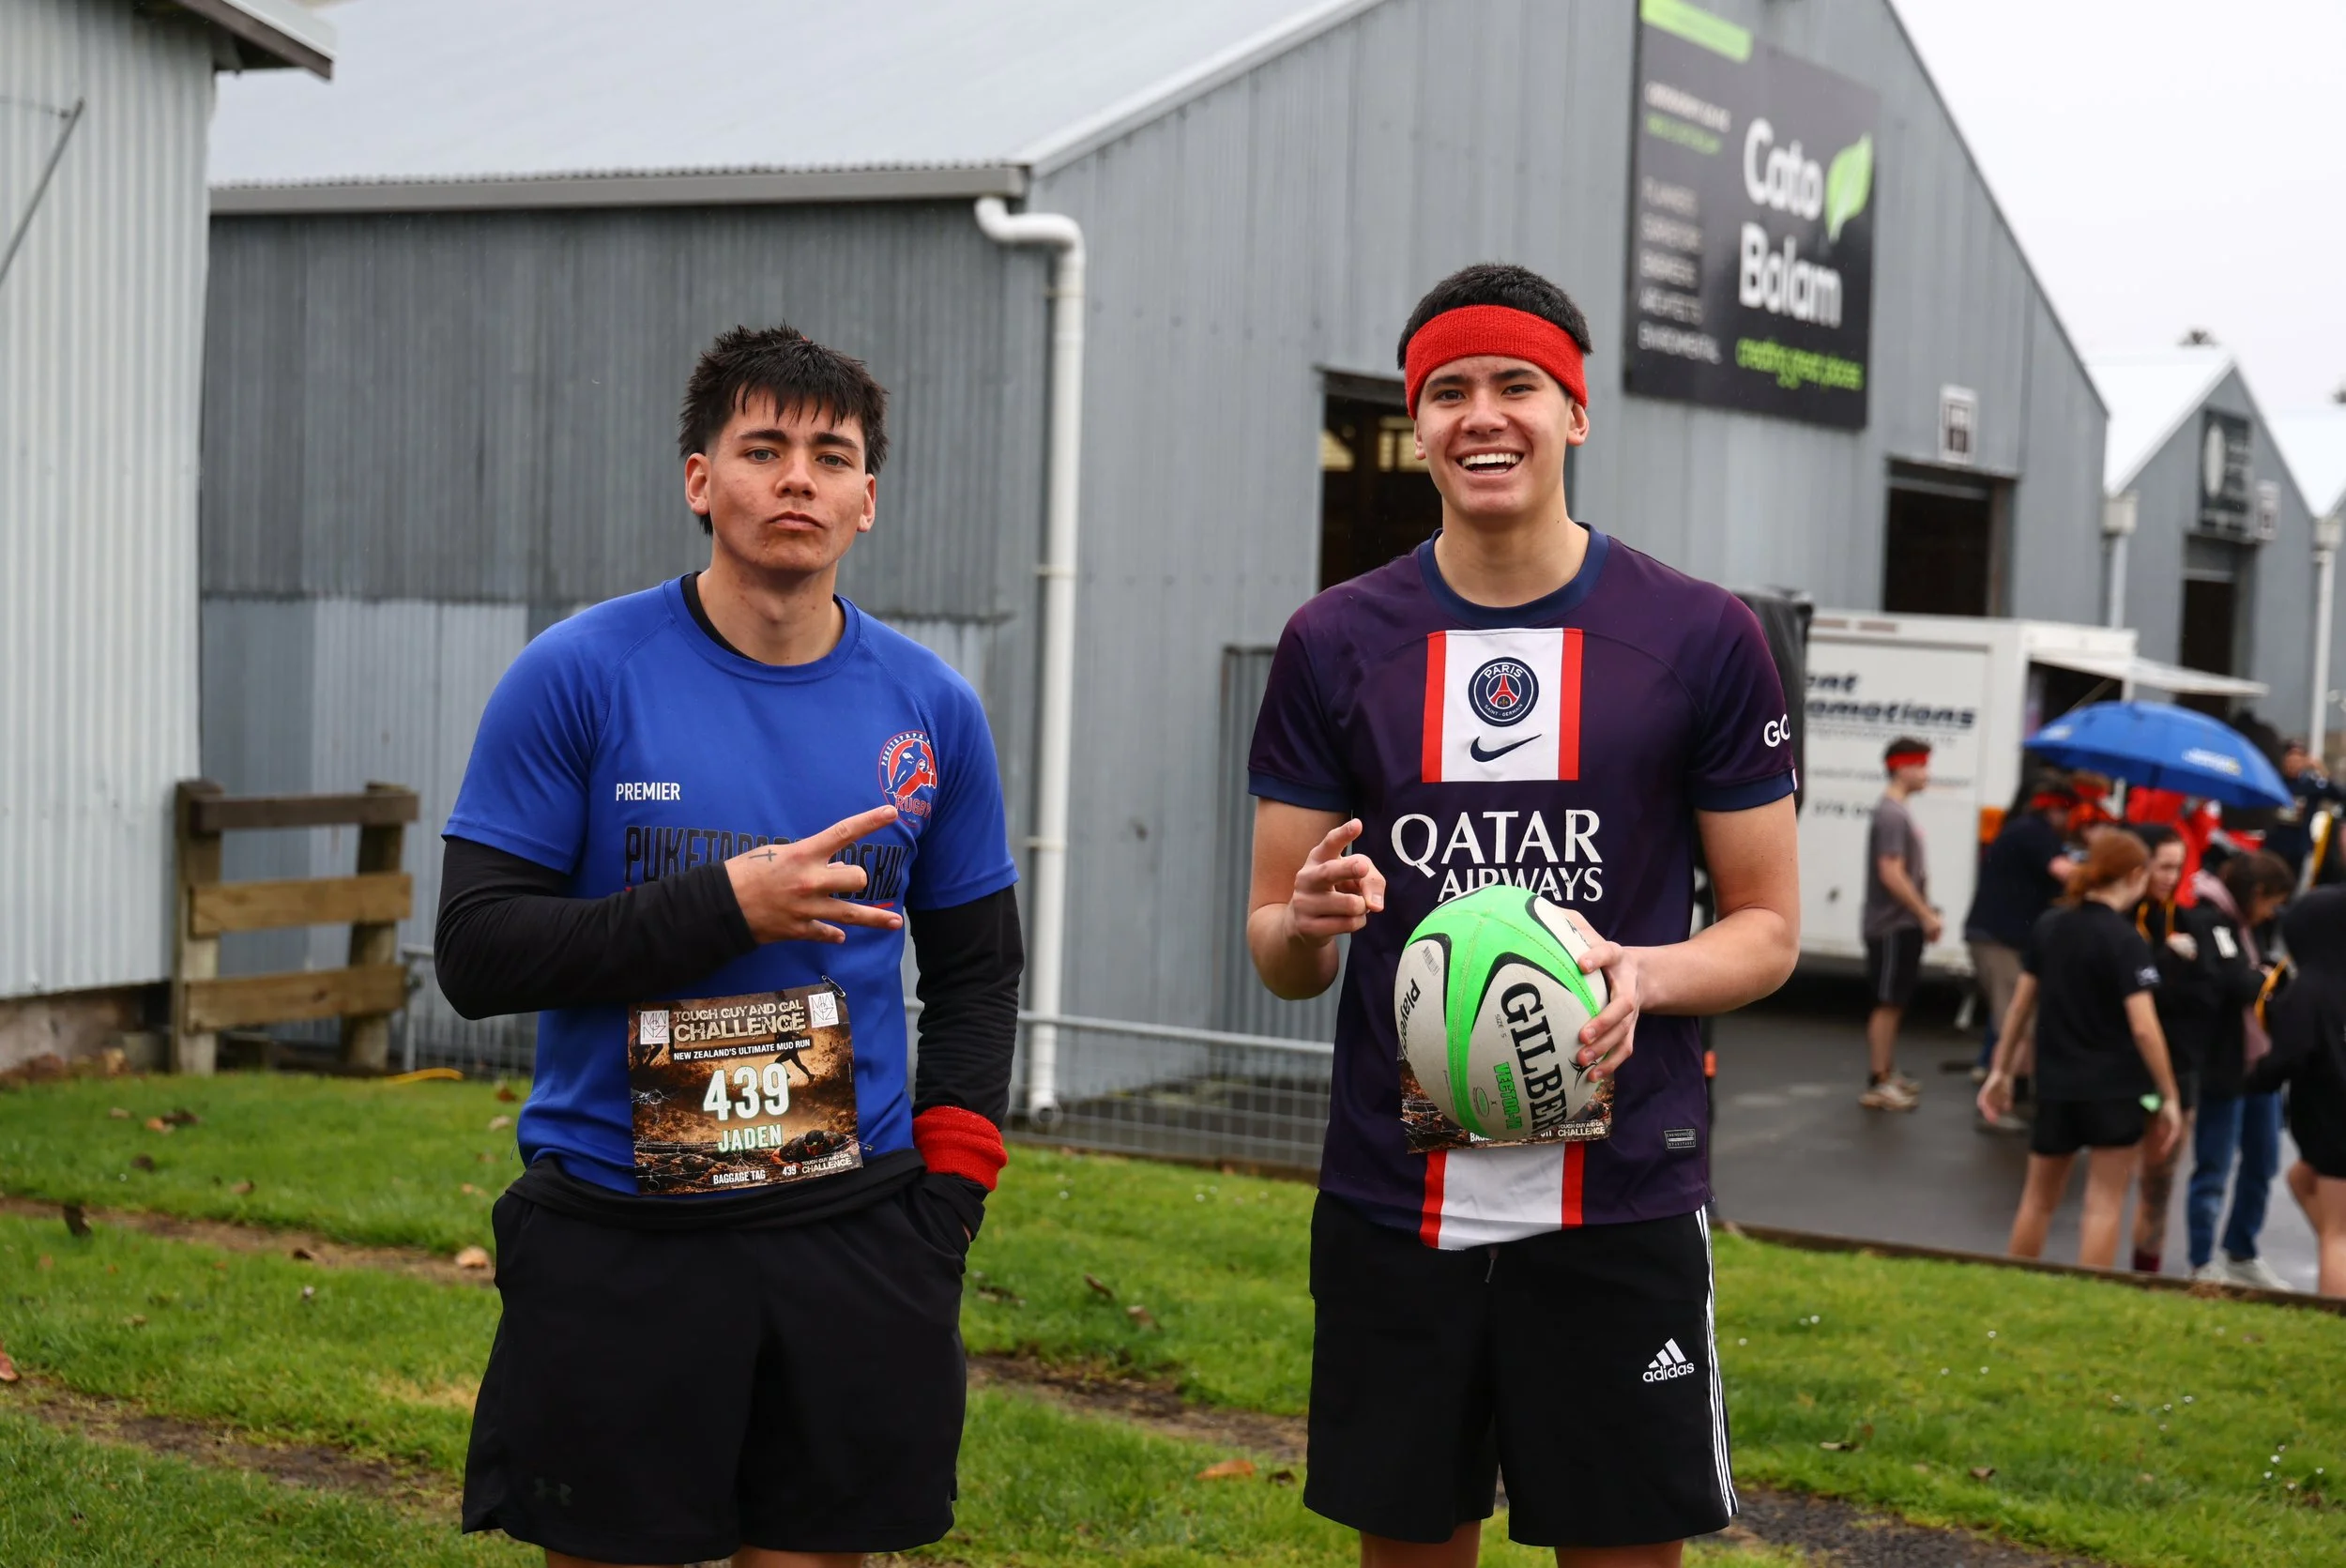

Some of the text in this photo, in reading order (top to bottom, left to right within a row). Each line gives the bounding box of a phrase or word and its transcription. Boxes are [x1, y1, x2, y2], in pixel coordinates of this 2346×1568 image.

[1744, 117, 1823, 221] Cato
[1739, 221, 1842, 328] Bolam
[1484, 664, 1523, 678] PARIS
[1484, 704, 1499, 716] SAINT
[616, 782, 680, 801] PREMIER
[1391, 809, 1603, 877] QATAR
[674, 1008, 718, 1023] TOUGH
[721, 1005, 748, 1018] GUY
[749, 1002, 776, 1015] AND
[674, 1012, 806, 1042] CHALLENGE
[674, 1039, 811, 1060] NEW ZEALAND'S ULTIMATE MUD RUN
[703, 1062, 789, 1120] 439
[718, 1123, 782, 1153] JADEN
[1558, 1127, 1606, 1137] CHALLENGE
[782, 1165, 797, 1177] 439
[801, 1157, 853, 1174] CHALLENGE
[713, 1169, 766, 1185] BAGGAGE TAG
[1642, 1362, 1695, 1382] adidas
